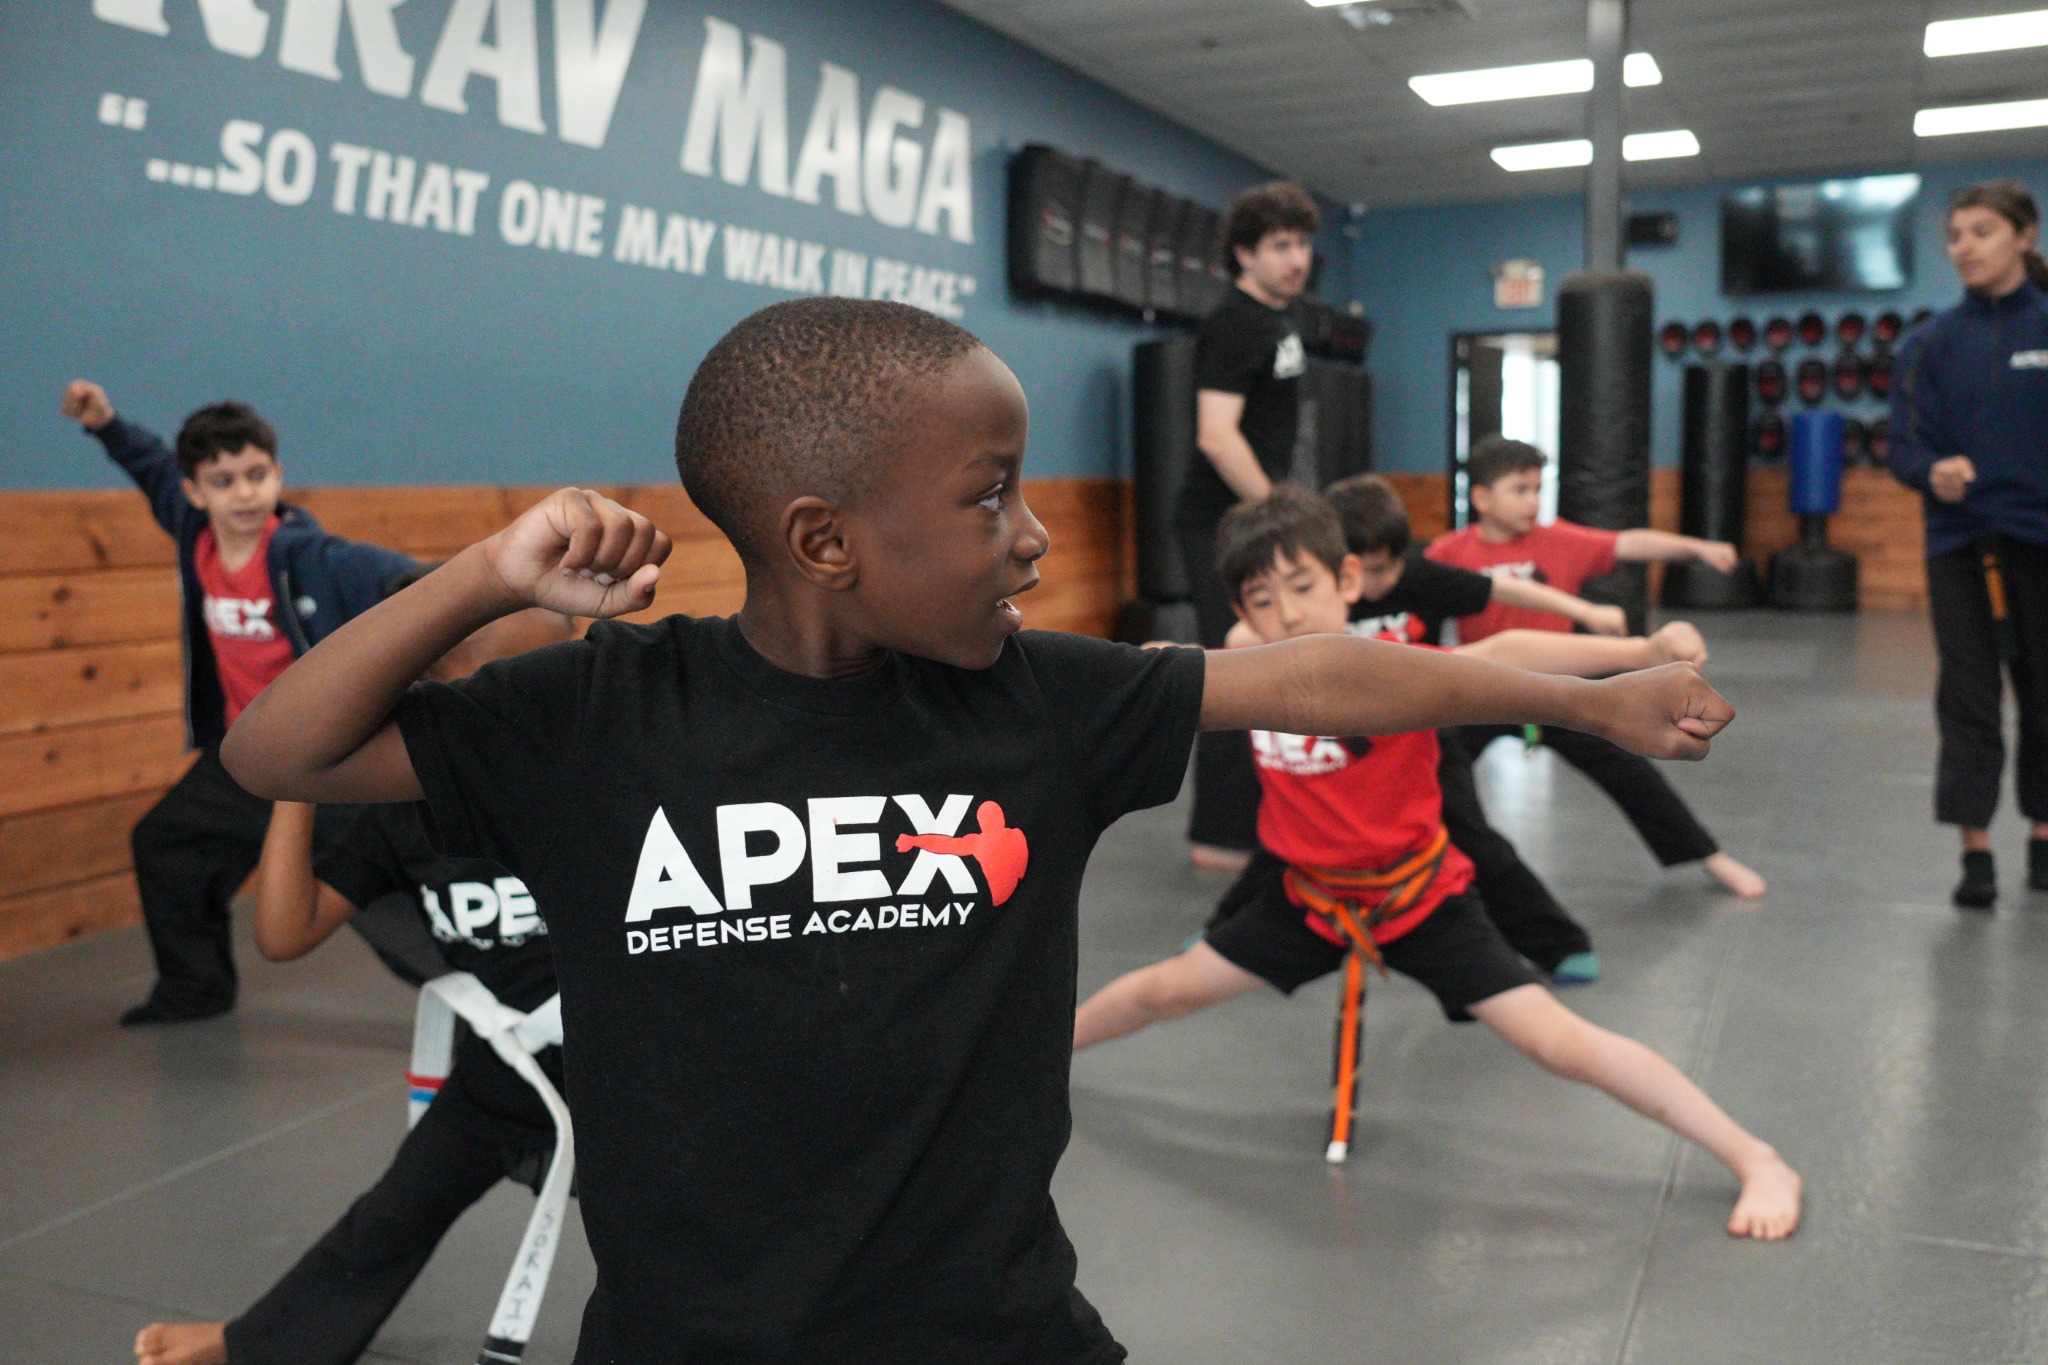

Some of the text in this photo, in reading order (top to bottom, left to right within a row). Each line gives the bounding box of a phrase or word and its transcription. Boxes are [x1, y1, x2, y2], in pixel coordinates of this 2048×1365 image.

[92, 0, 974, 245] AV MAGA
[330, 142, 490, 236] THAT
[501, 179, 606, 258] ONE
[614, 203, 716, 276] MAY
[724, 224, 827, 293] WALK
[830, 248, 868, 299] IN
[625, 794, 978, 922] APEX
[627, 902, 975, 955] DEFENSE ACADEMY
